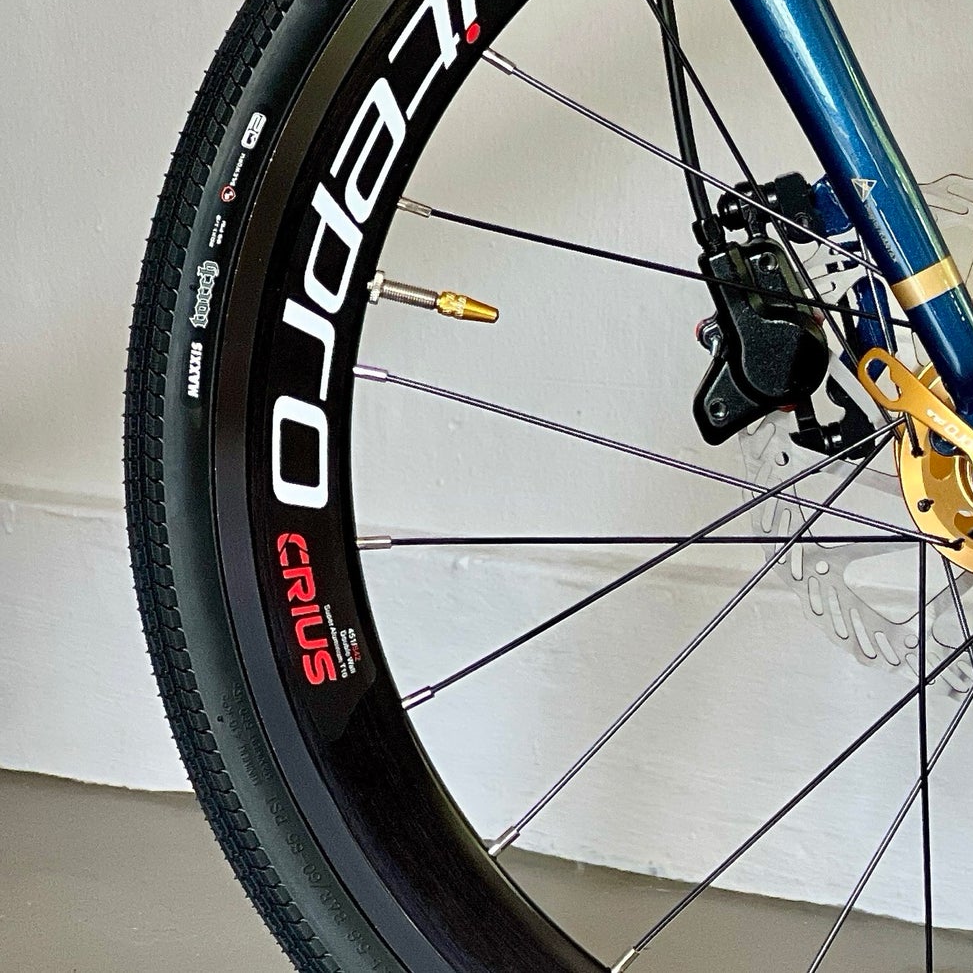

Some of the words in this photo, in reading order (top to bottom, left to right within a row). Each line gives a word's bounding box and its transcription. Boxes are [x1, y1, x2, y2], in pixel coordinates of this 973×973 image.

[189, 260, 219, 328] torch
[187, 341, 203, 398] MAXXIS
[277, 533, 337, 685] CRIUS
